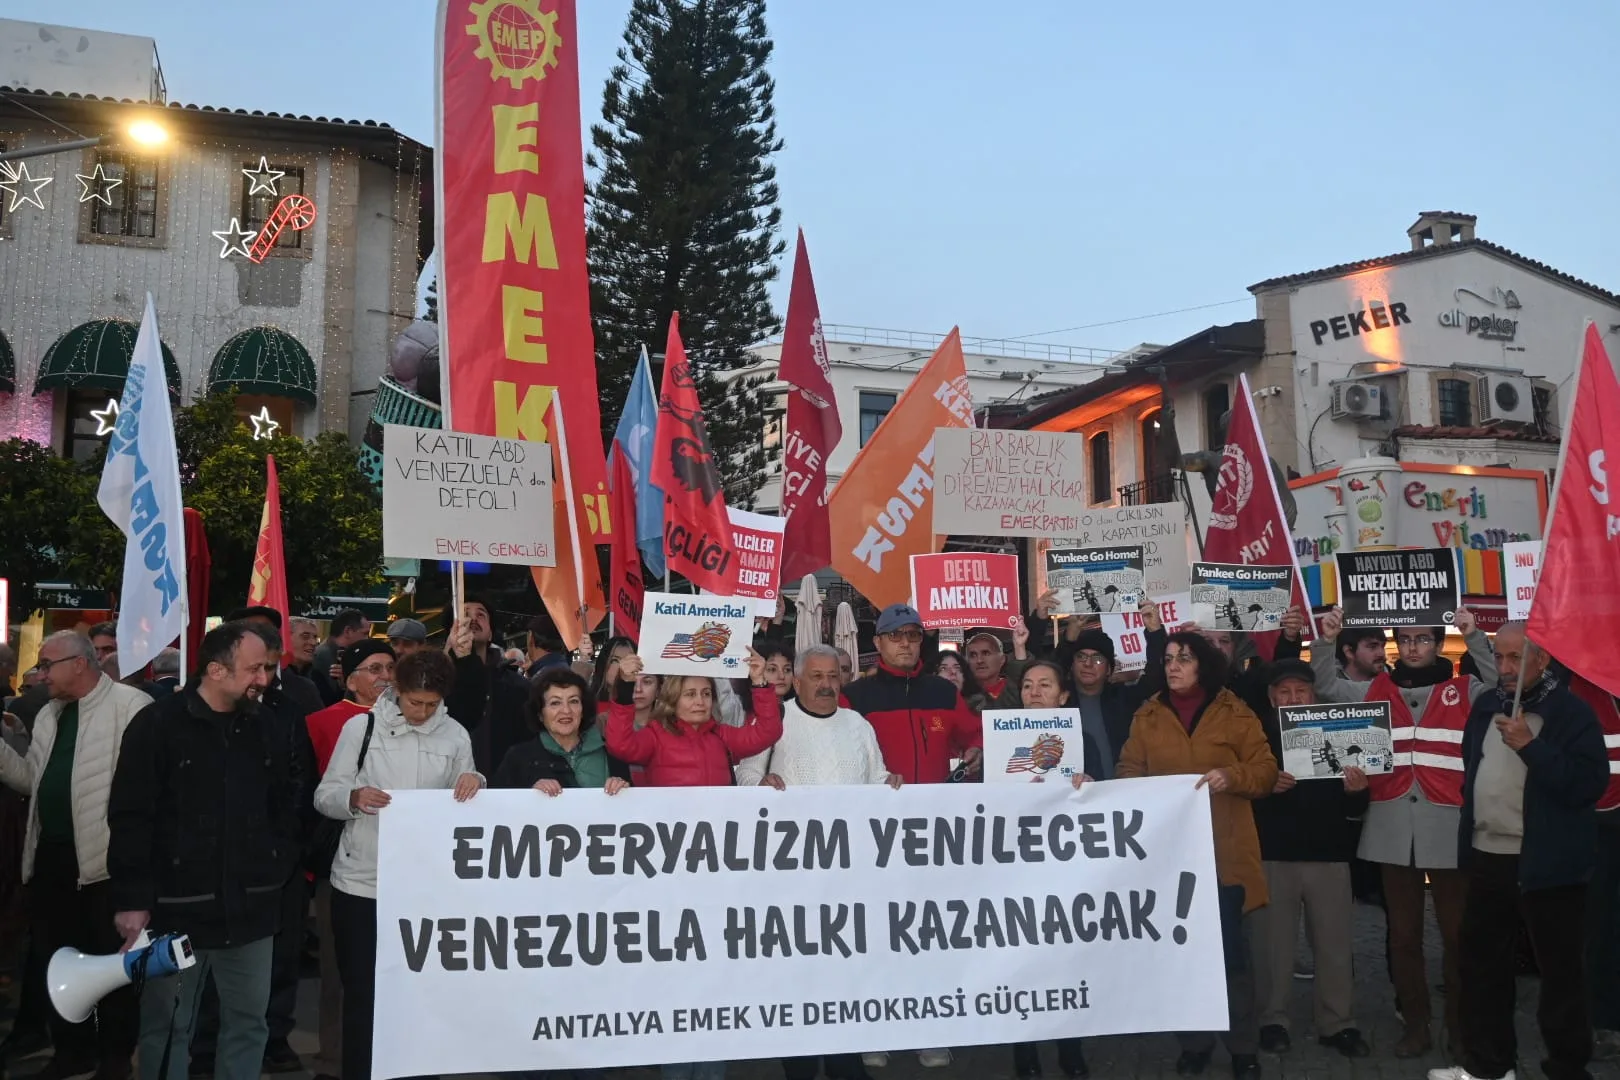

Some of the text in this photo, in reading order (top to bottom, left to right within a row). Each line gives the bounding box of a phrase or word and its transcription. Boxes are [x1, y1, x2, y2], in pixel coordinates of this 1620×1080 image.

[492, 20, 545, 50] EMEP
[482, 102, 559, 444] EMEK
[1310, 302, 1412, 345] PEKER
[489, 438, 526, 464] ABD
[970, 430, 1068, 460] BARBARLIK
[961, 456, 1062, 478] YENİLECEK!
[944, 473, 1082, 501] DİRENEN HALKLAR
[964, 496, 1046, 514] KAZANACAK!
[1001, 514, 1042, 529] EMEK
[436, 538, 480, 555] EMEK
[1051, 550, 1140, 563] Yankee Go Home!
[944, 559, 991, 582] DEFOL
[1197, 566, 1288, 580] Yankee Go Home!
[1355, 553, 1435, 572] HAYDUT ABD
[1348, 571, 1448, 591] VENEZUELA'DAN
[930, 583, 1009, 611] AMERİKA!
[1367, 590, 1430, 611] ELİNİ ÇEK!
[655, 602, 746, 618] Katil Amerika!
[1346, 616, 1374, 625] TÜRKİYE
[1120, 632, 1142, 654] GO
[993, 716, 1073, 731] Katil Amerika!
[1286, 706, 1384, 722] Yankee Go Home!
[453, 804, 1147, 880] EMPERYALİZM YENİLECEK
[398, 908, 707, 972] VENEZUELA
[724, 902, 867, 961] HALKI
[532, 980, 1090, 1041] ANTALYA EMEK VE DEMOKRASİ GÜÇLERİ
